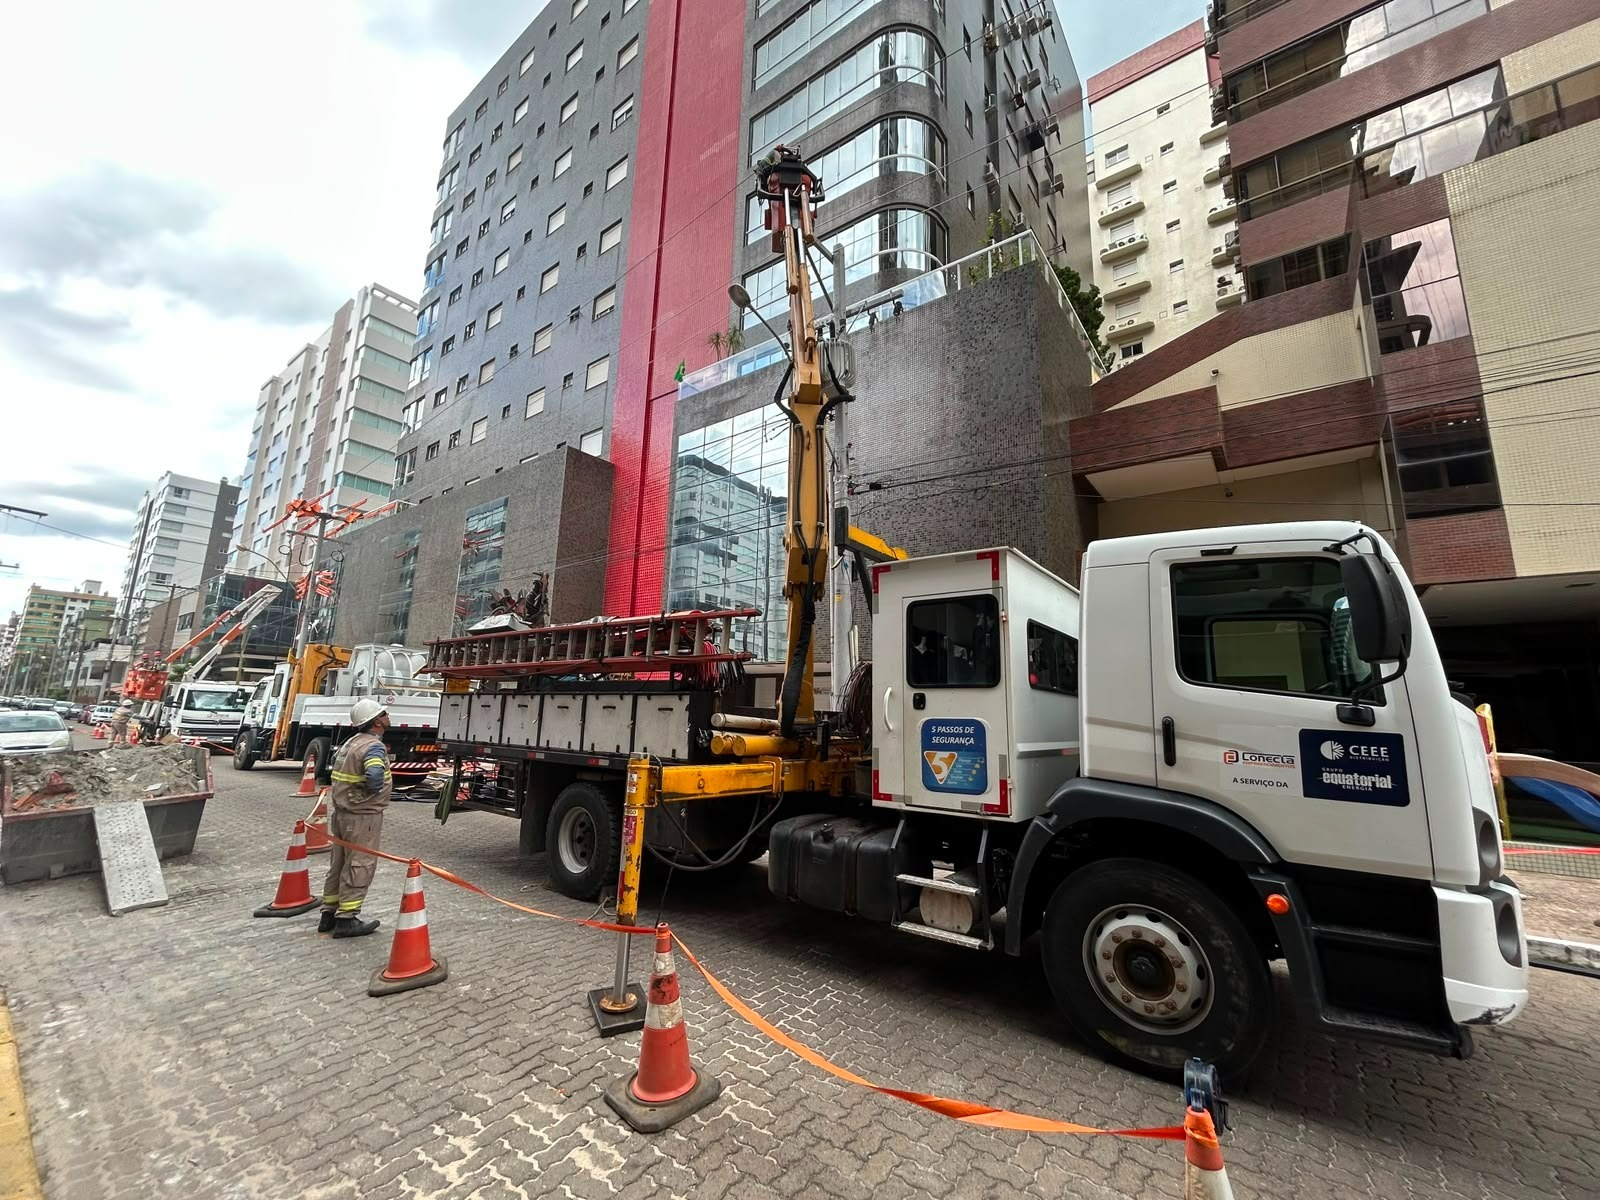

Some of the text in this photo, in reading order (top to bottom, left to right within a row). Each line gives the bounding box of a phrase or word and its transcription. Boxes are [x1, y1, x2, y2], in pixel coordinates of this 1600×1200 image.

[931, 725, 975, 734] 5 PASSOS DE
[931, 736, 975, 746] SEGURANÇA
[1349, 745, 1389, 758] CEEE
[1240, 777, 1275, 787] SERVIÇO
[1322, 772, 1393, 789] equatorial
[1342, 784, 1373, 792] ENERGIA
